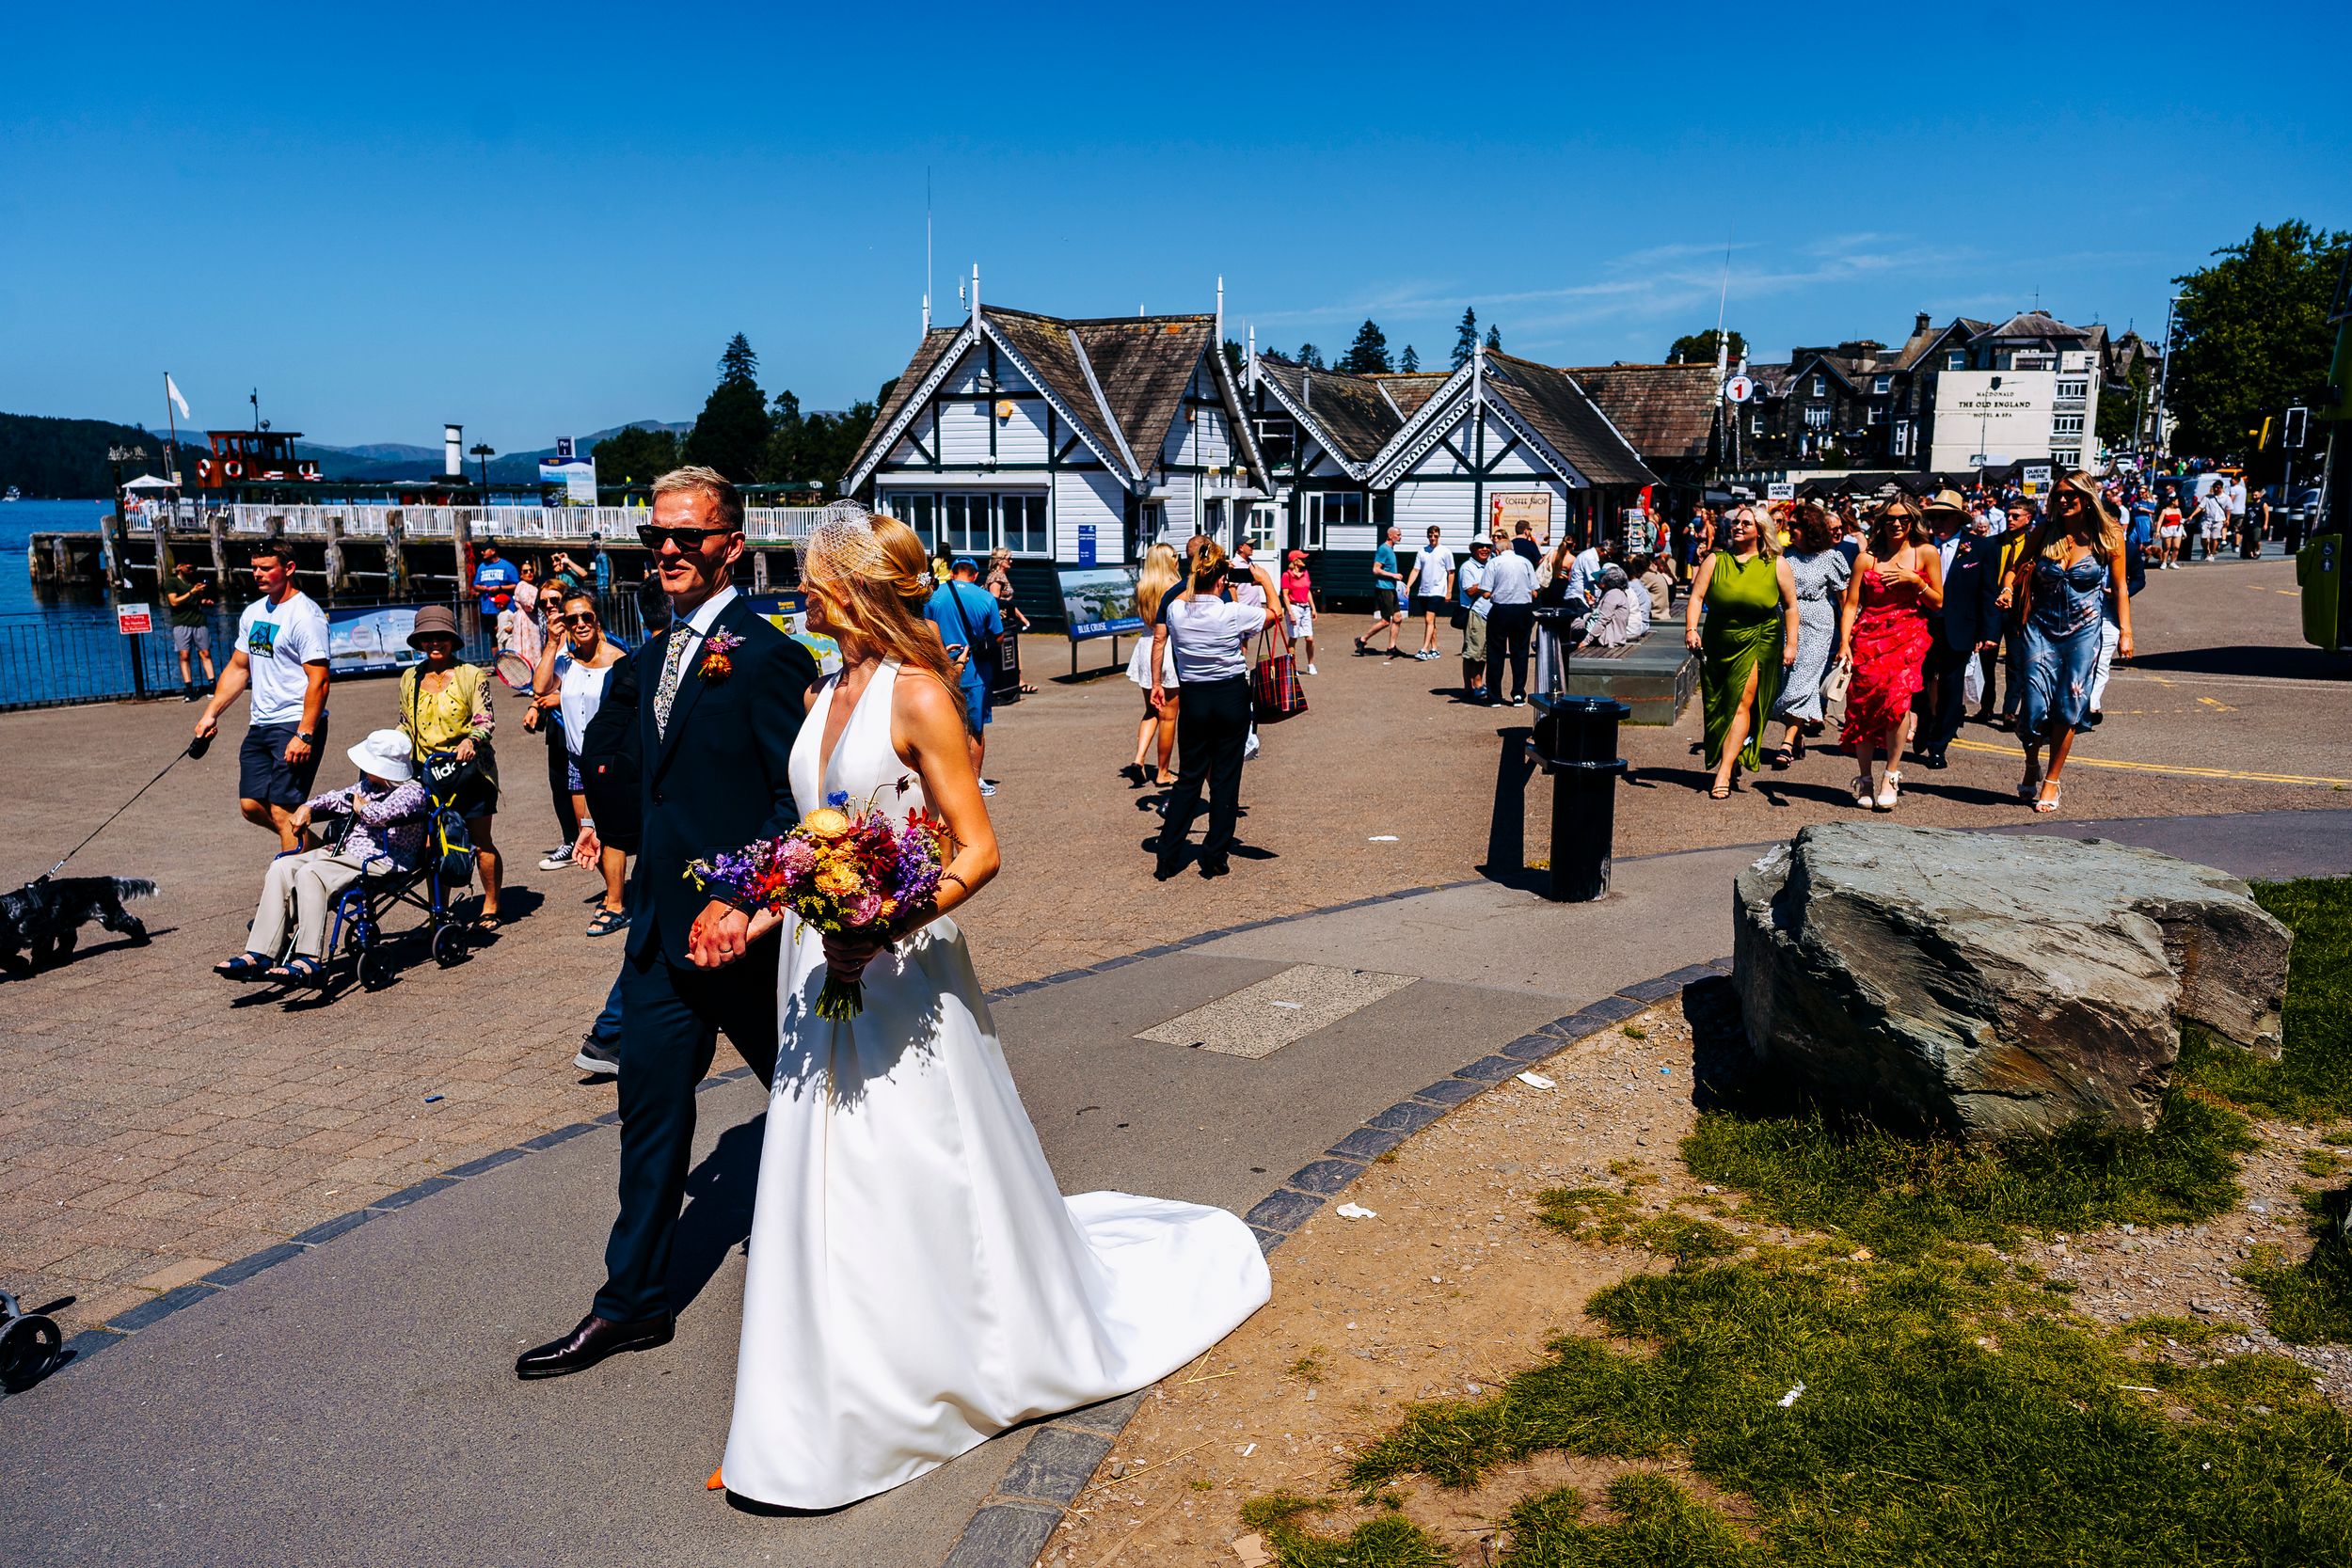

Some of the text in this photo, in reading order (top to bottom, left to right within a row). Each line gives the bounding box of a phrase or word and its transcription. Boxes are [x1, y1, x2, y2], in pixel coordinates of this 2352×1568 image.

[1734, 384, 1742, 399] 1
[1505, 497, 1548, 506] COFFEE SHOP
[1077, 625, 1090, 634] BLUE
[1090, 622, 1107, 632] CRUISE
